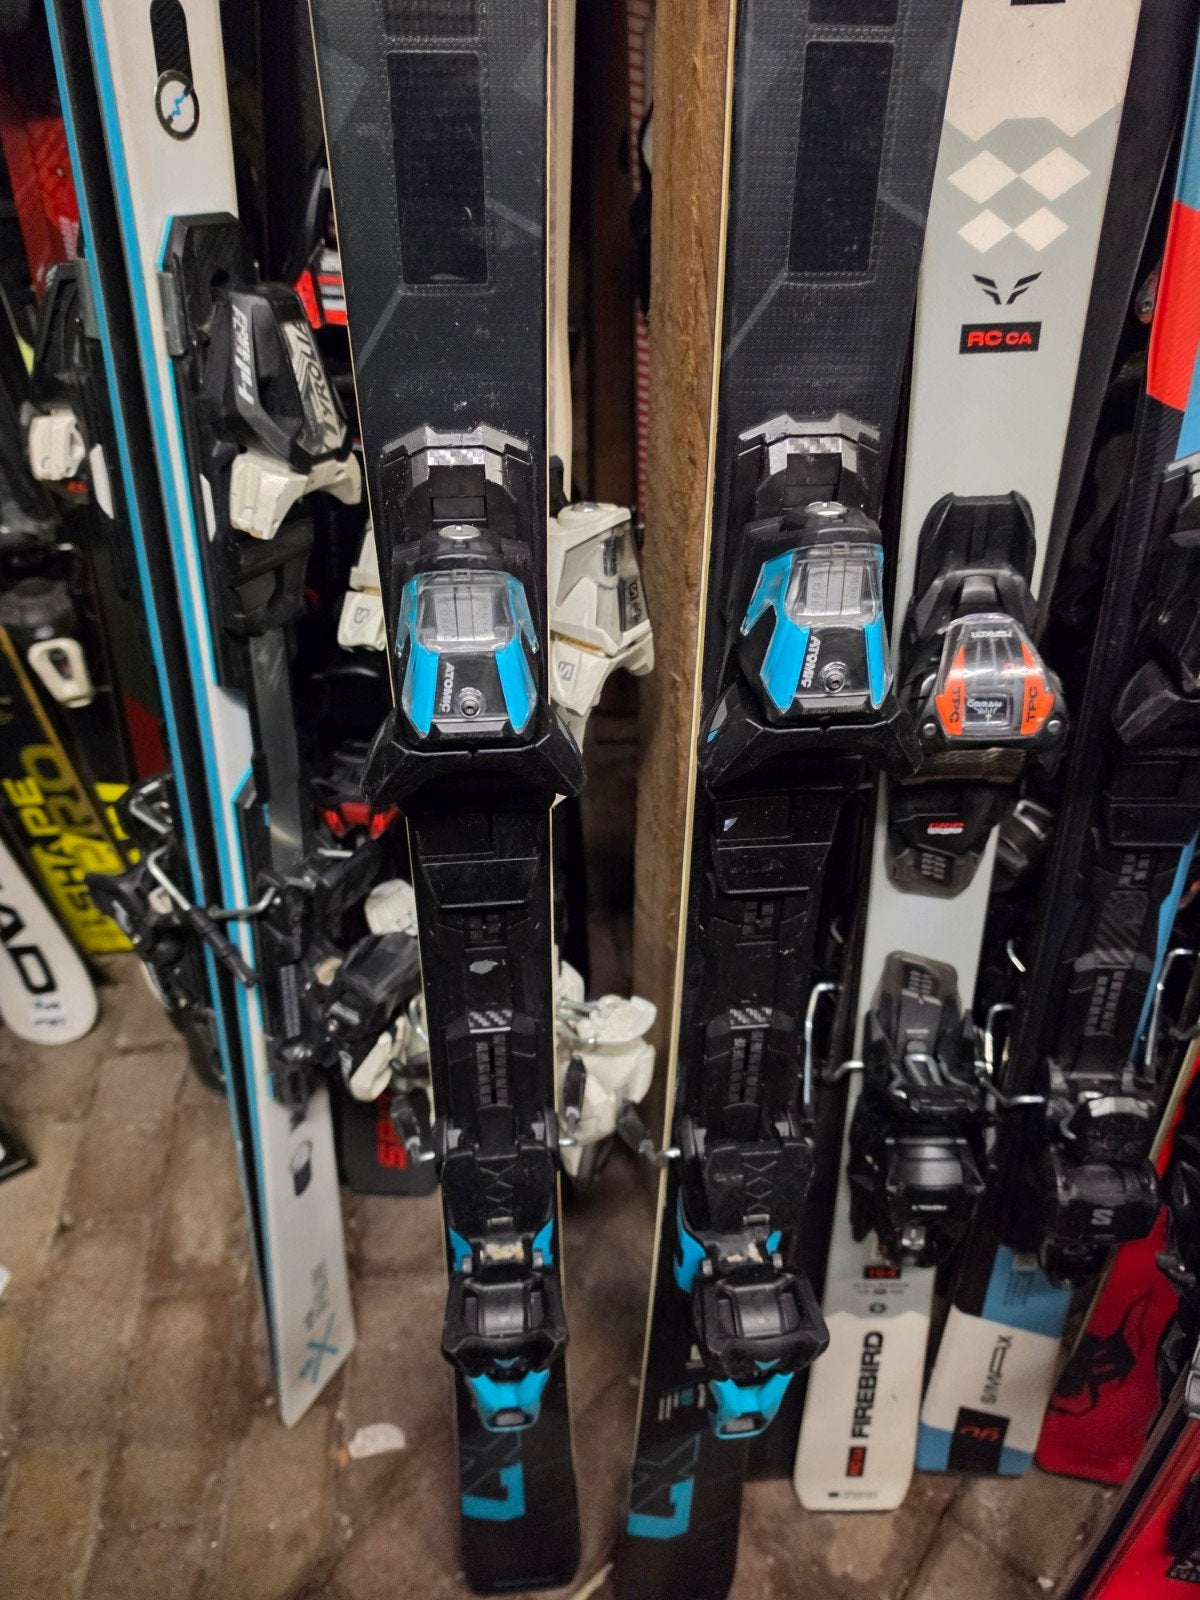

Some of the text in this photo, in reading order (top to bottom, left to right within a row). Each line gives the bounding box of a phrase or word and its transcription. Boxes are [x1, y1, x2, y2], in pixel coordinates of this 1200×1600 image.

[967, 330, 1032, 346] RC CA
[801, 635, 822, 689] ATOMIC
[440, 661, 455, 713] ATOMIC
[949, 686, 961, 723] TPC
[1026, 686, 1038, 723] TPC
[1091, 1209, 1114, 1226] S
[851, 1330, 884, 1439] FIREBIRD
